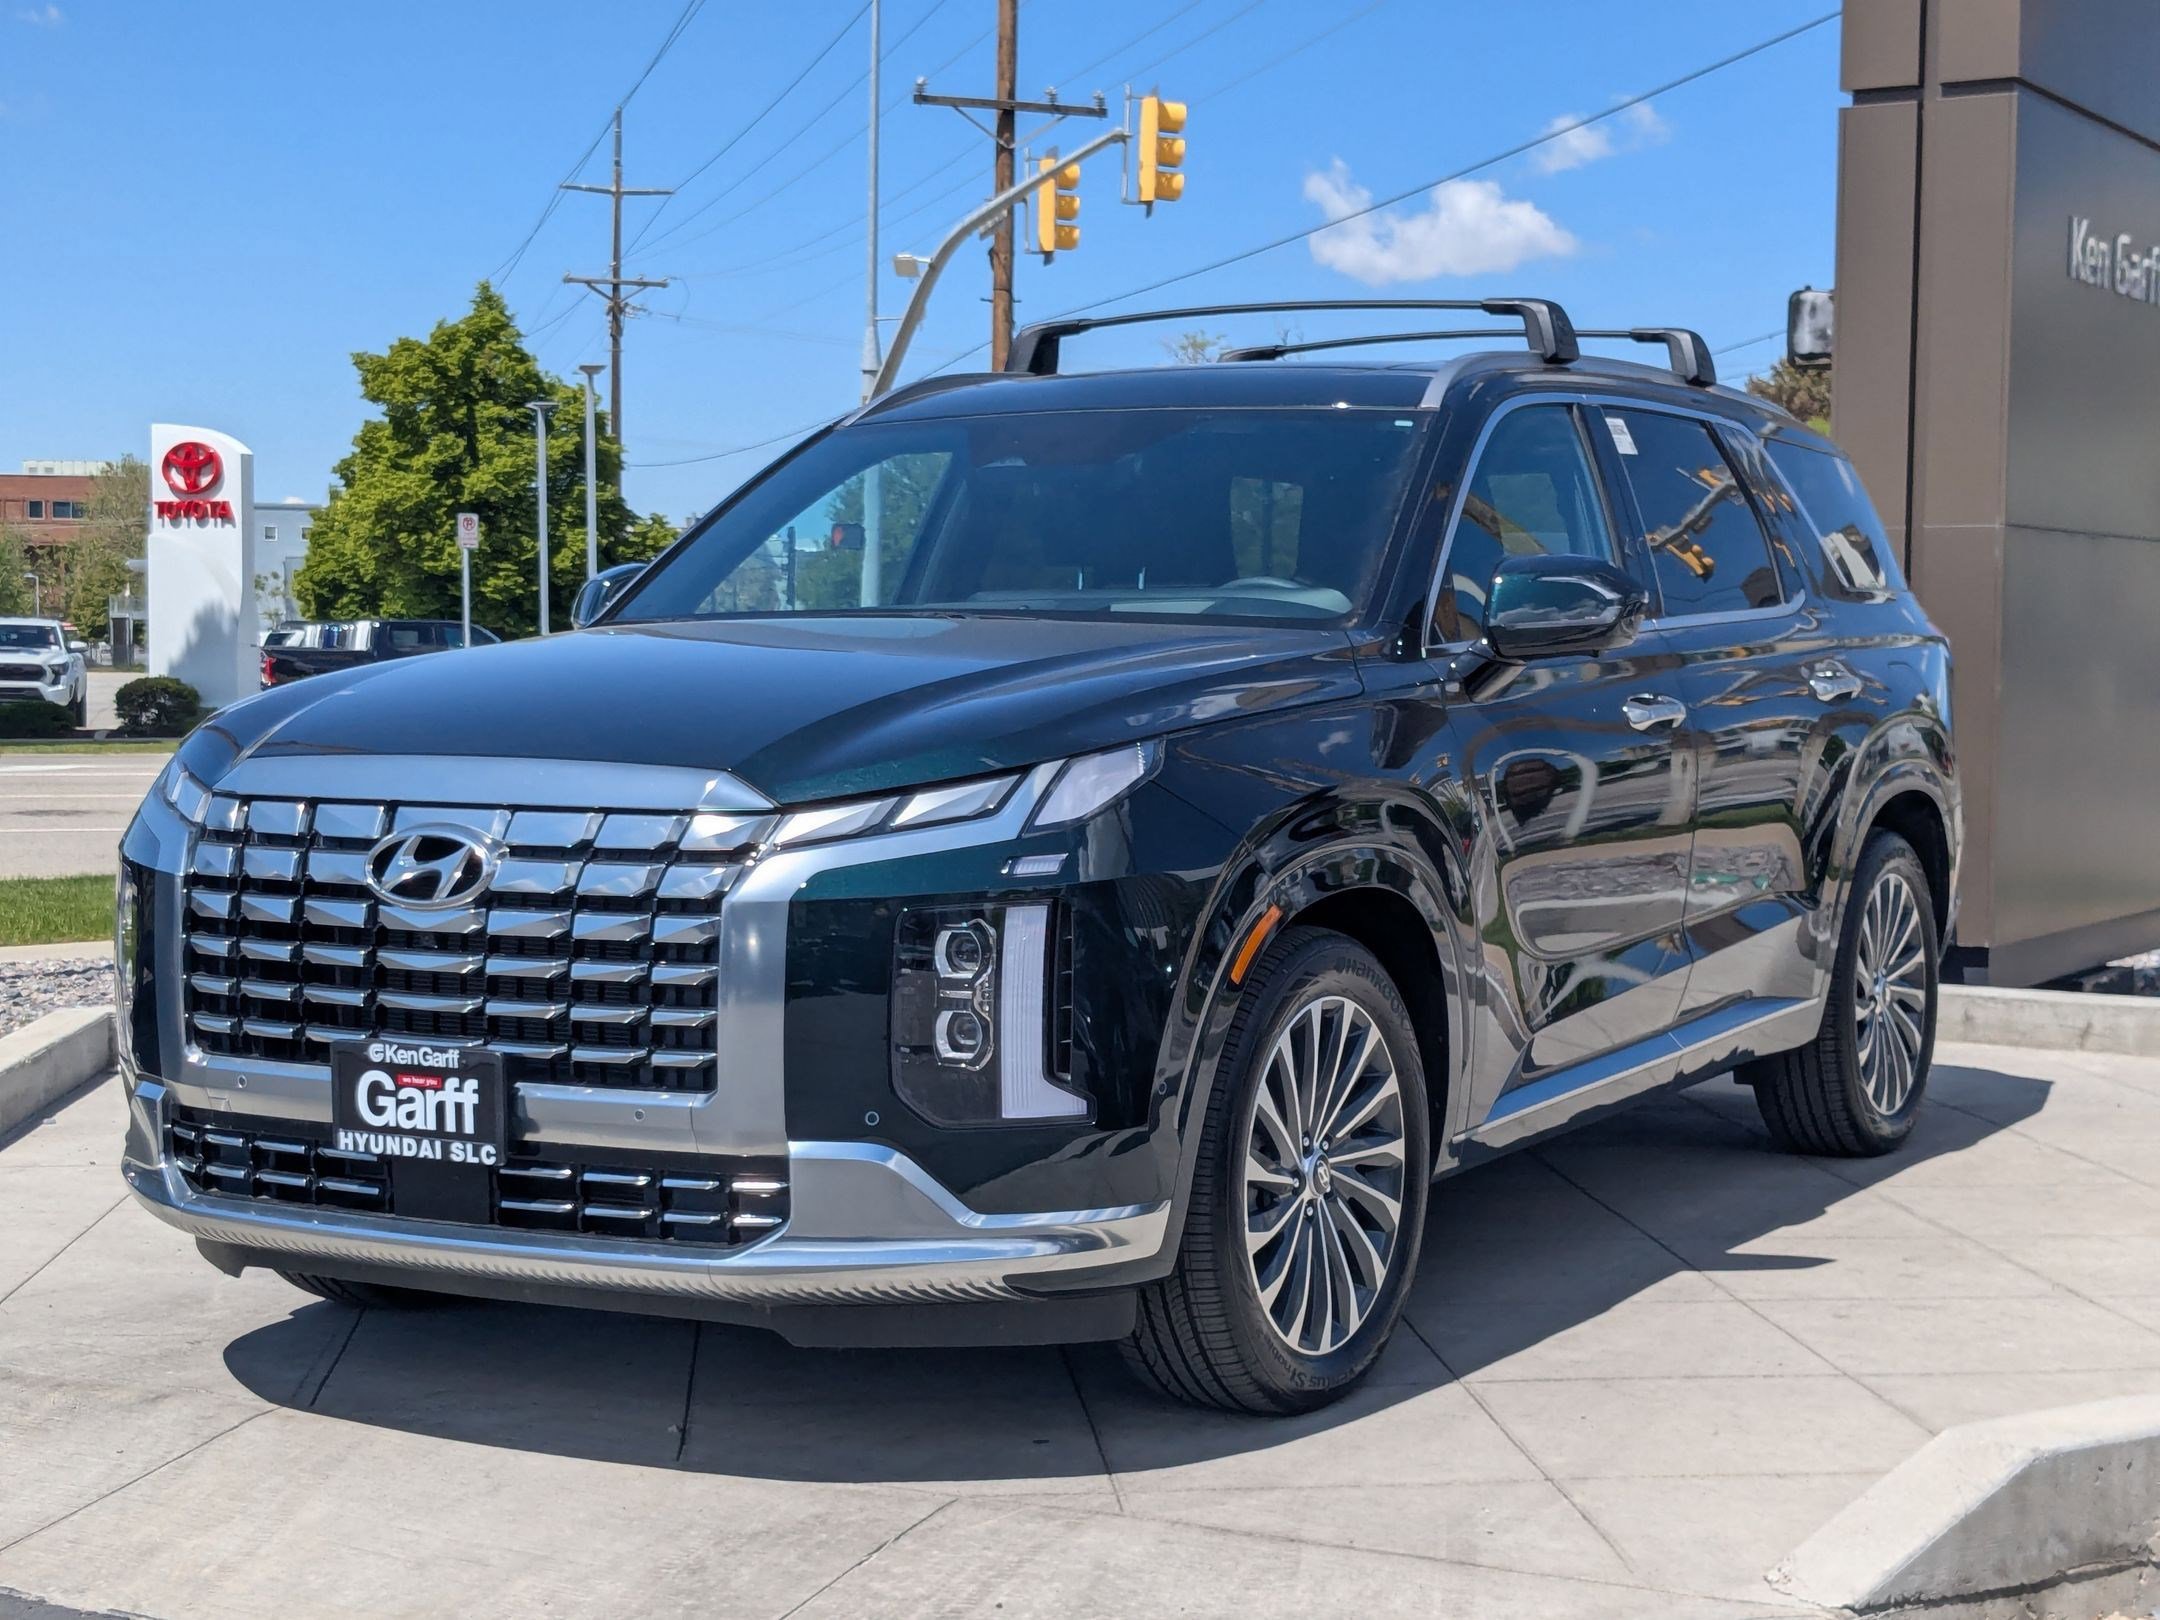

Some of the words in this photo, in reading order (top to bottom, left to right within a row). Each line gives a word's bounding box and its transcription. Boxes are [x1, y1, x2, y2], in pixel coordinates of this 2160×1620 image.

[2068, 216, 2109, 289] Ken
[2113, 233, 2160, 305] Garf
[154, 500, 233, 520] TOYOTA
[357, 1070, 479, 1134] Garff
[339, 1131, 442, 1159] HYUNDAI
[450, 1142, 496, 1165] SLC
